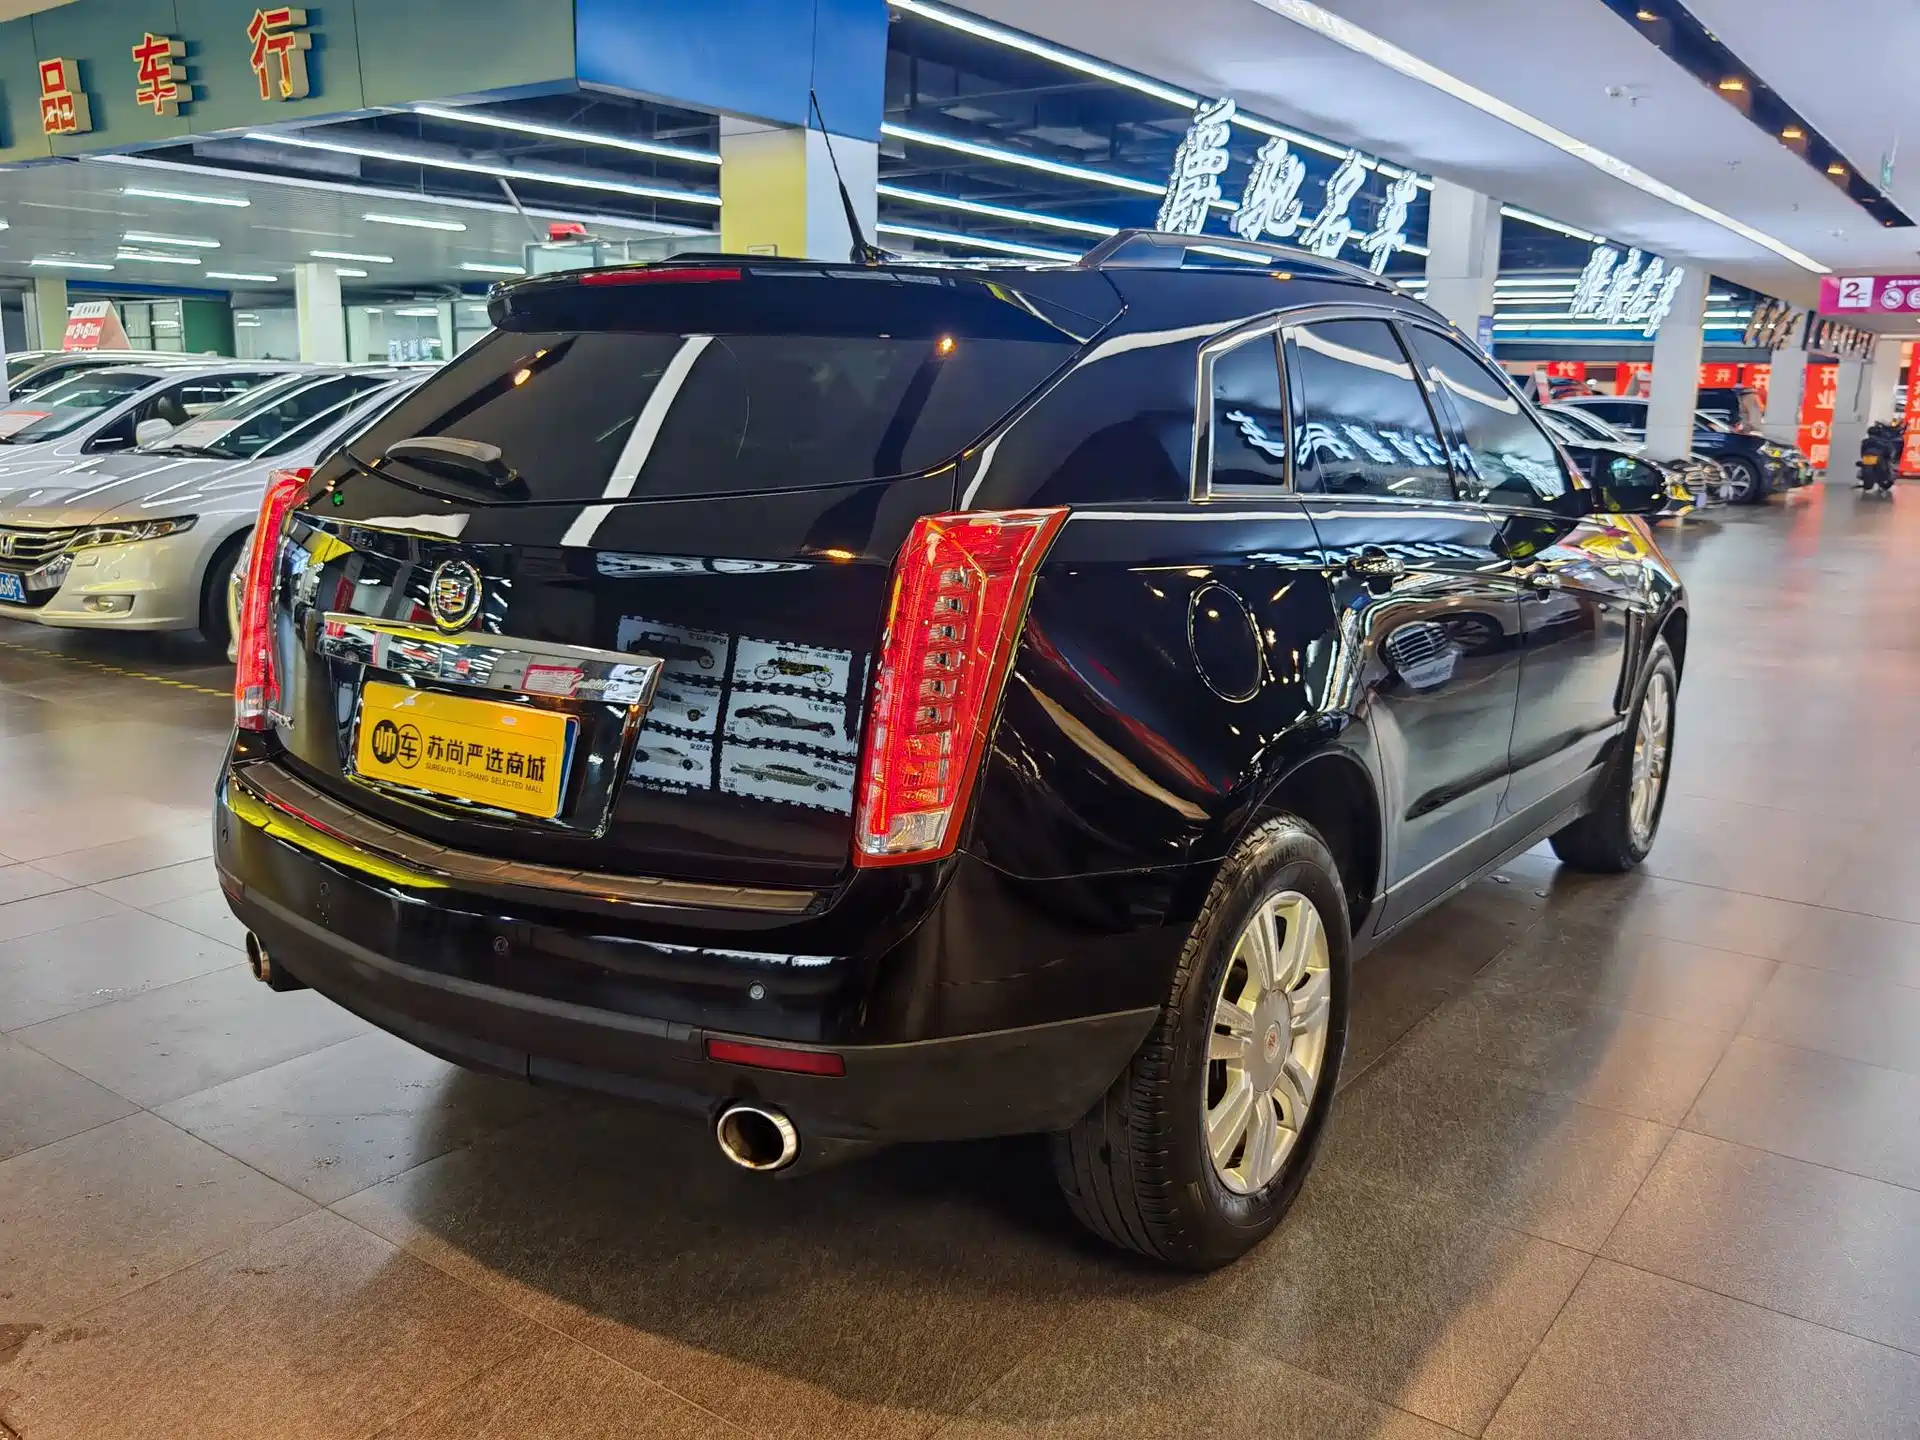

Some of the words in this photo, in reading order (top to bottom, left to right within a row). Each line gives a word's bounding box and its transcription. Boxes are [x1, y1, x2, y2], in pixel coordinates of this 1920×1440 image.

[39, 7, 300, 135] 品车行
[425, 761, 457, 775] SUREAUTO
[457, 768, 489, 782] SUSHANG
[490, 776, 524, 790] SELECTED
[525, 784, 544, 794] MALL
[426, 734, 547, 782] 苏尚严选商城
